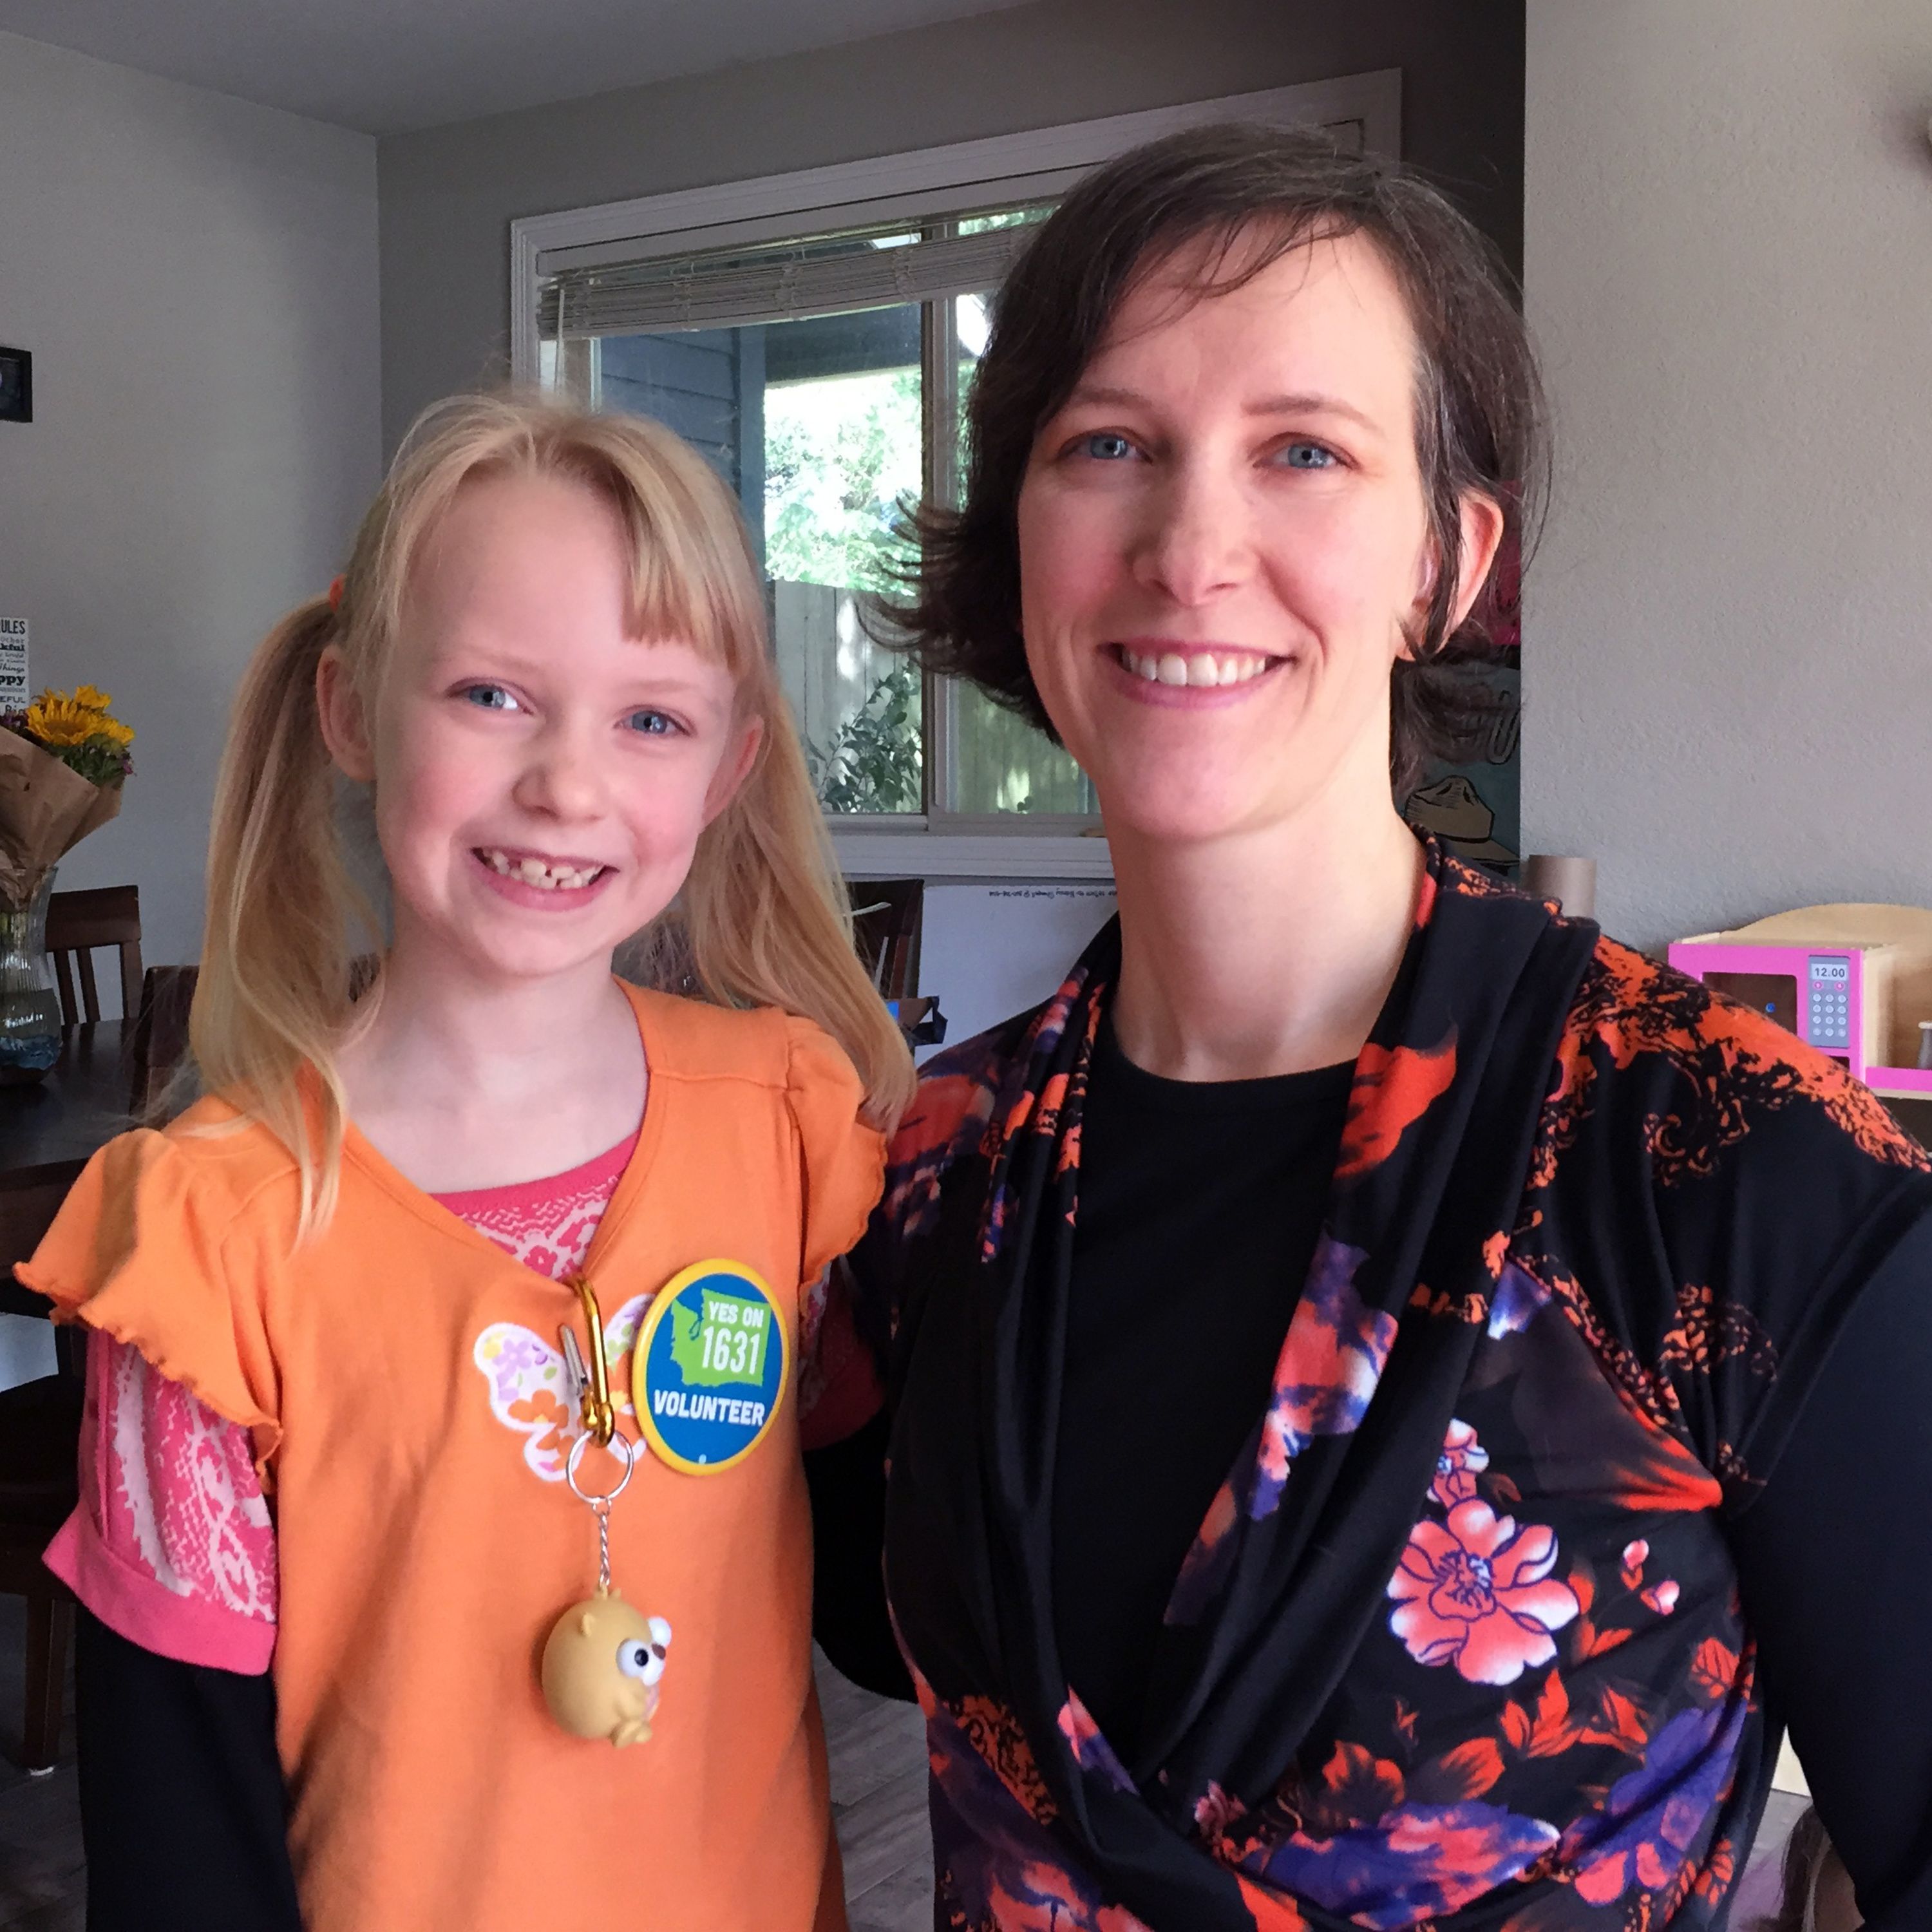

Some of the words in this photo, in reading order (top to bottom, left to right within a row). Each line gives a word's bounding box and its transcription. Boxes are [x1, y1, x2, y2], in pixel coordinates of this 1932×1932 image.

[0, 620, 26, 634] ULES
[0, 675, 26, 686] ppy
[709, 1301, 739, 1324] YES
[743, 1307, 764, 1328] ON
[703, 1326, 761, 1375] 1631
[654, 1389, 766, 1426] VOLUNTEER
